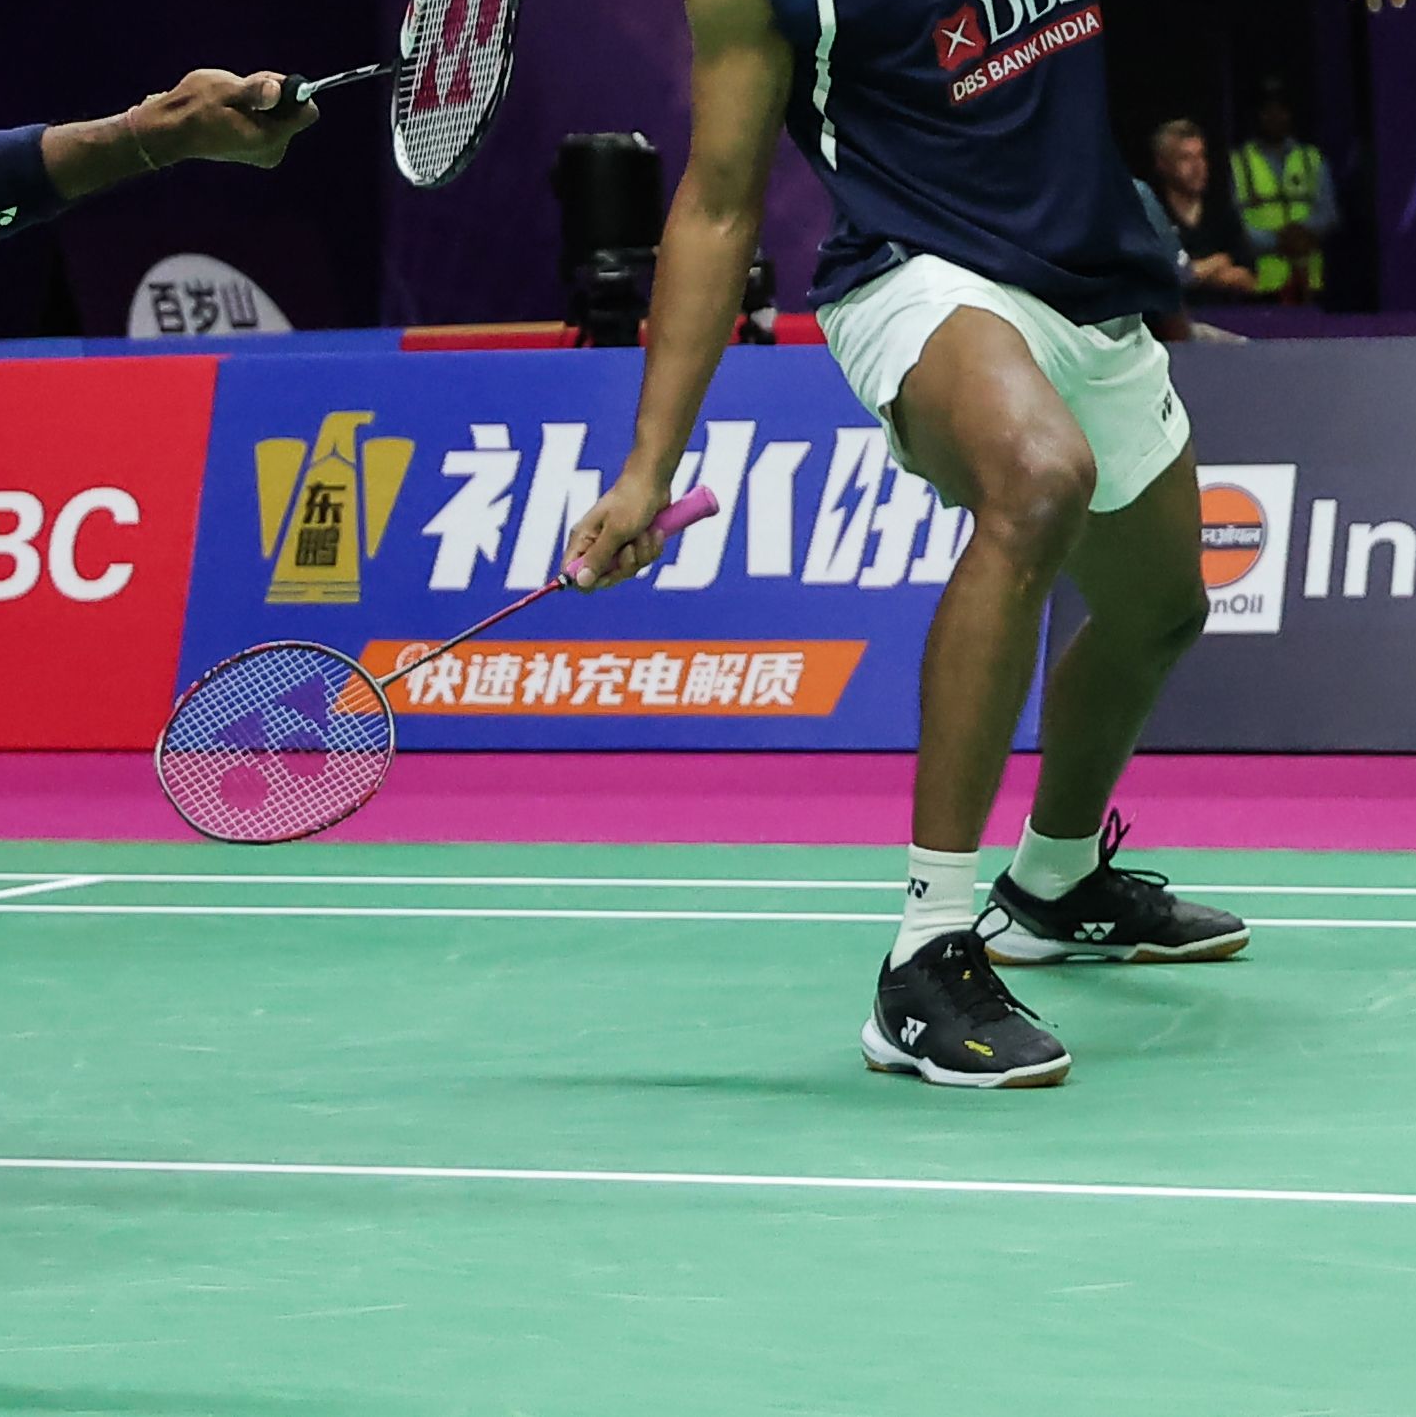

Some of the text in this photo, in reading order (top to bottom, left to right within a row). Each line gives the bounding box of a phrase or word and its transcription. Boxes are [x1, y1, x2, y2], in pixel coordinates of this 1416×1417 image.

[952, 11, 1100, 101] DBS BANK INDIA
[147, 279, 259, 334] 百岁山
[294, 480, 347, 567] 东鹏
[406, 649, 805, 707] 快速补充电解质
